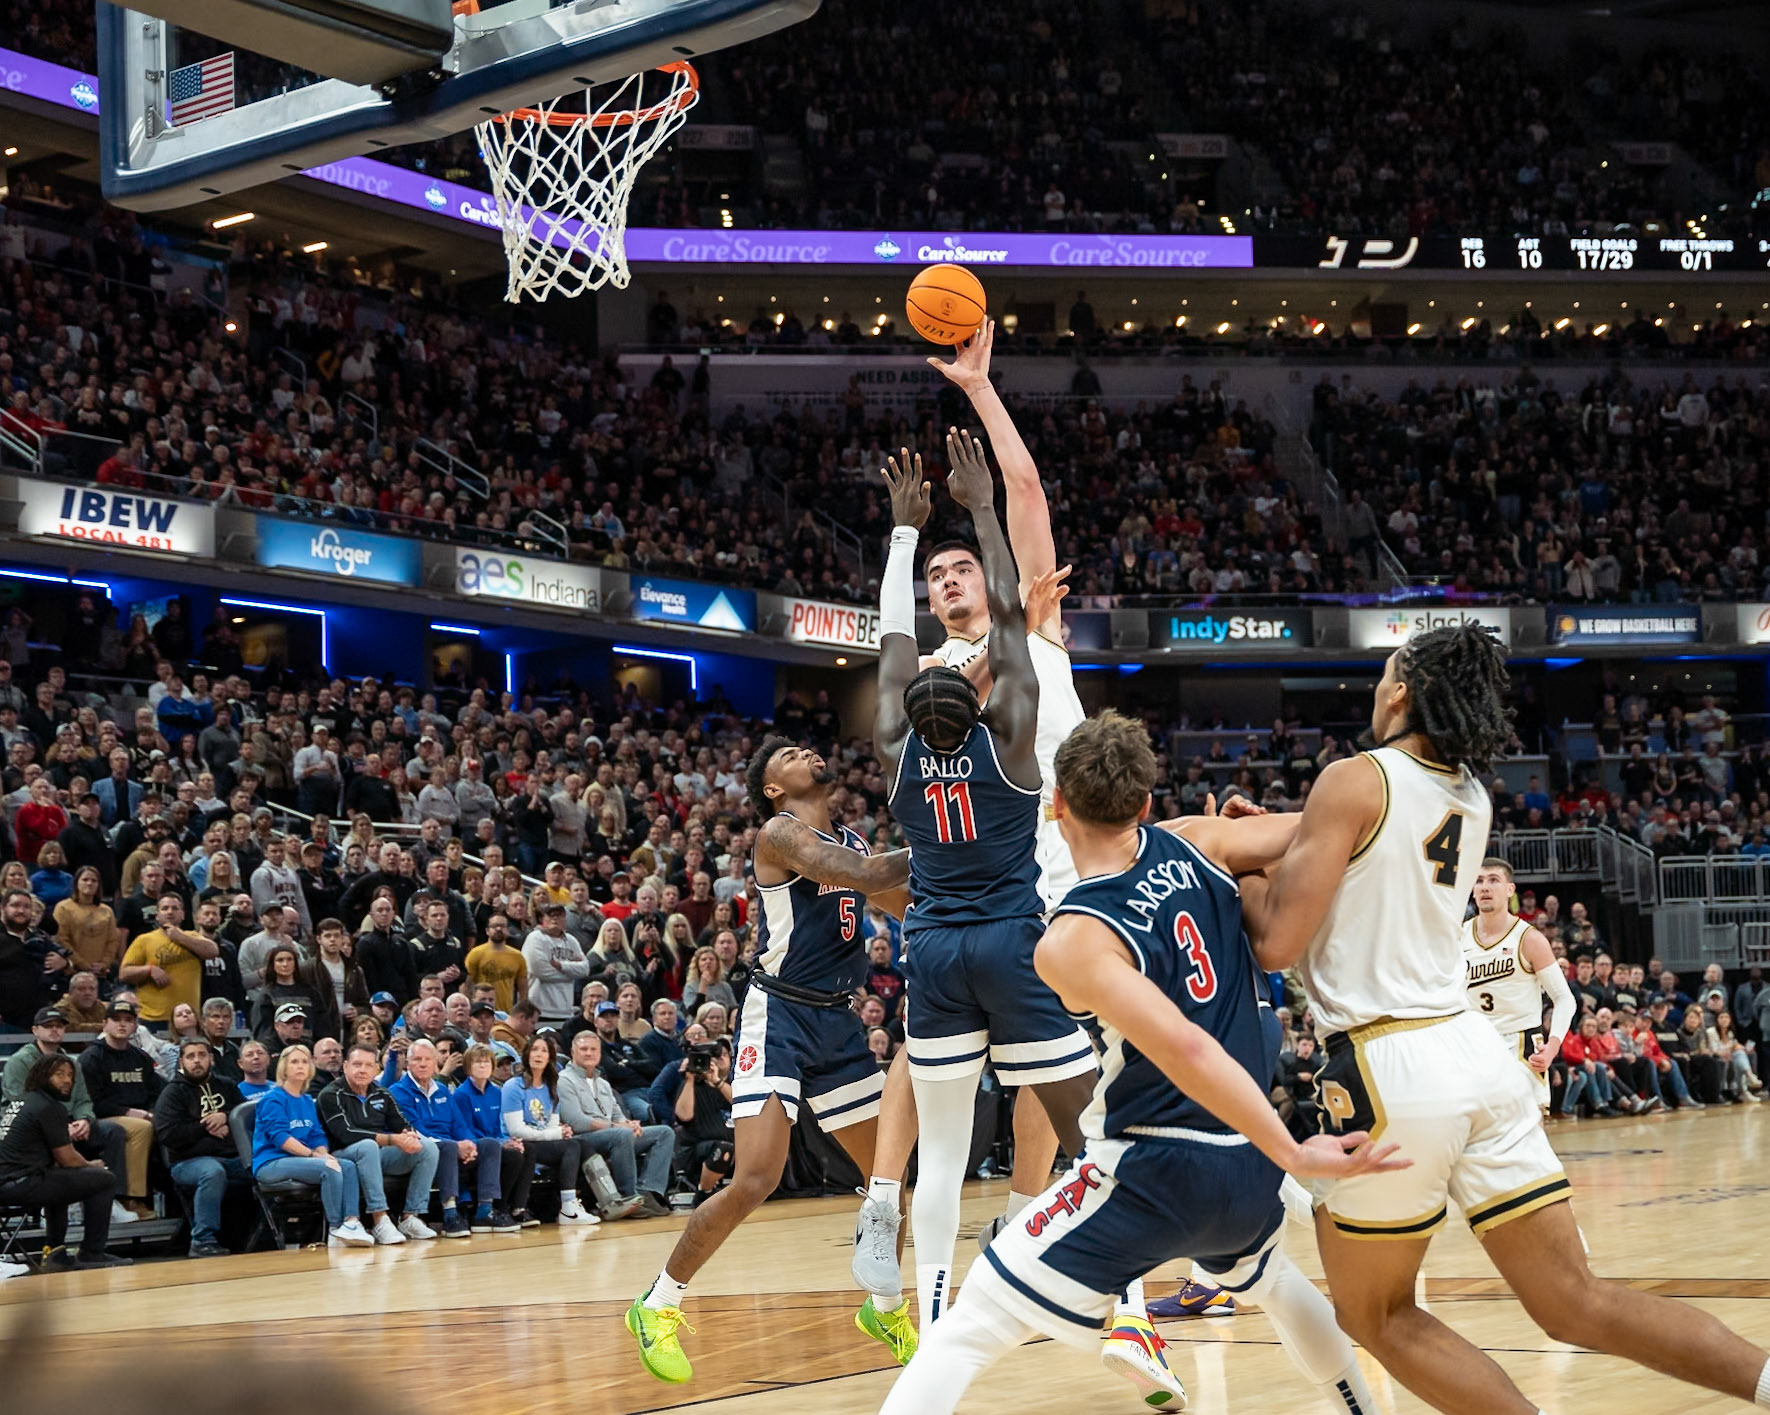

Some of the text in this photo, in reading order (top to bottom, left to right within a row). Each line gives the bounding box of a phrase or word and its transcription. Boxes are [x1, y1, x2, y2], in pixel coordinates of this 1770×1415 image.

[663, 236, 828, 263] CareSource
[917, 244, 1008, 262] CareSource
[1050, 239, 1208, 266] CareSource
[1518, 238, 1540, 250] AST
[1570, 239, 1638, 251] FIELD GOALS
[1659, 239, 1734, 252] FREE THROWS
[1461, 250, 1486, 269] 16
[1518, 250, 1543, 269] 10
[1577, 250, 1634, 270] 17/29
[1680, 250, 1712, 271] 0/1
[857, 370, 896, 384] NEED
[60, 487, 178, 533] IBEW
[58, 524, 172, 551] LOCAL 481
[310, 529, 372, 575] Kroger
[459, 554, 598, 608] aes Indiana
[640, 587, 686, 606] Elevance
[1415, 611, 1472, 636] slack
[1622, 618, 1674, 633] BASKETBALL
[919, 755, 973, 779] BALLO
[924, 781, 977, 843] 11
[1423, 809, 1464, 889] 4
[1122, 859, 1201, 933] LARSON
[839, 897, 856, 941] 5
[1173, 910, 1218, 1003] 3
[1479, 992, 1494, 1012] 3
[1025, 1163, 1107, 1237] CATS
